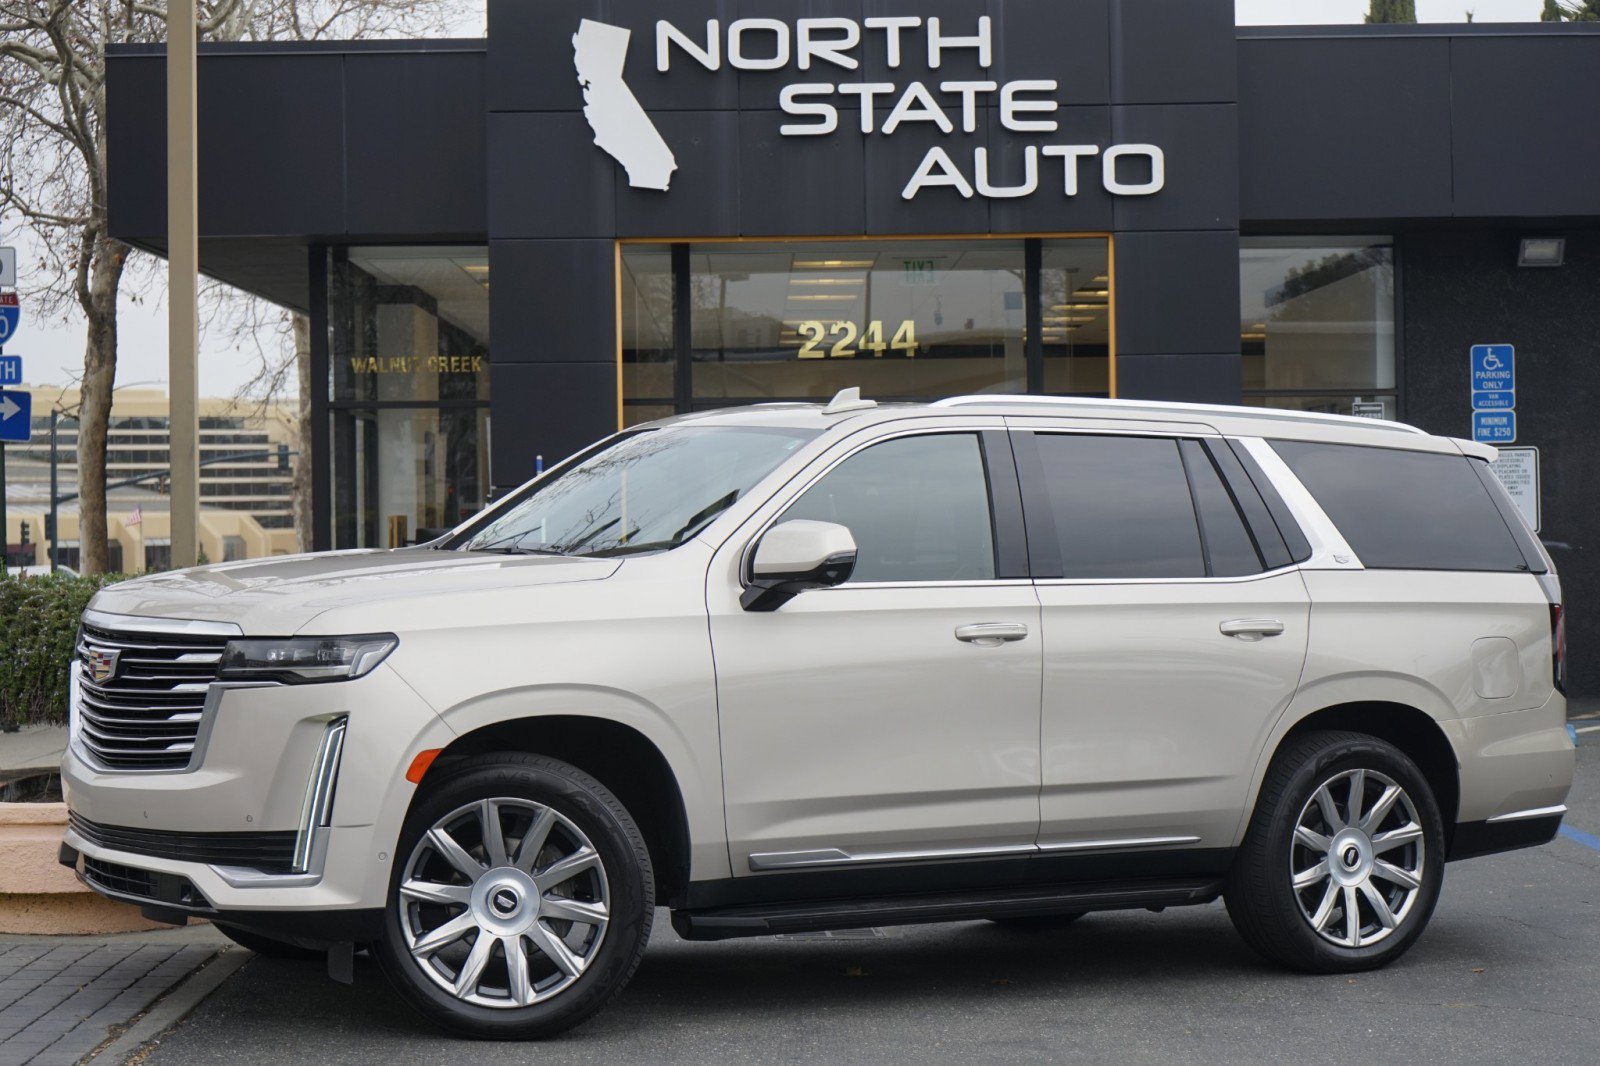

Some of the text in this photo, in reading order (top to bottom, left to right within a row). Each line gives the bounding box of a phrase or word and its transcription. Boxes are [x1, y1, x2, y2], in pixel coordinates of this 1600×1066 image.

[656, 15, 992, 72] NORTH
[779, 80, 1058, 135] STATE
[902, 144, 1164, 199] AUTO
[797, 320, 919, 358] 2244
[352, 356, 481, 373] WALNUT CREEK
[1475, 371, 1511, 379] PARKING
[1482, 381, 1504, 389] ONLY
[1481, 416, 1507, 425] MINIMUM
[1477, 427, 1511, 437] FINE $250
